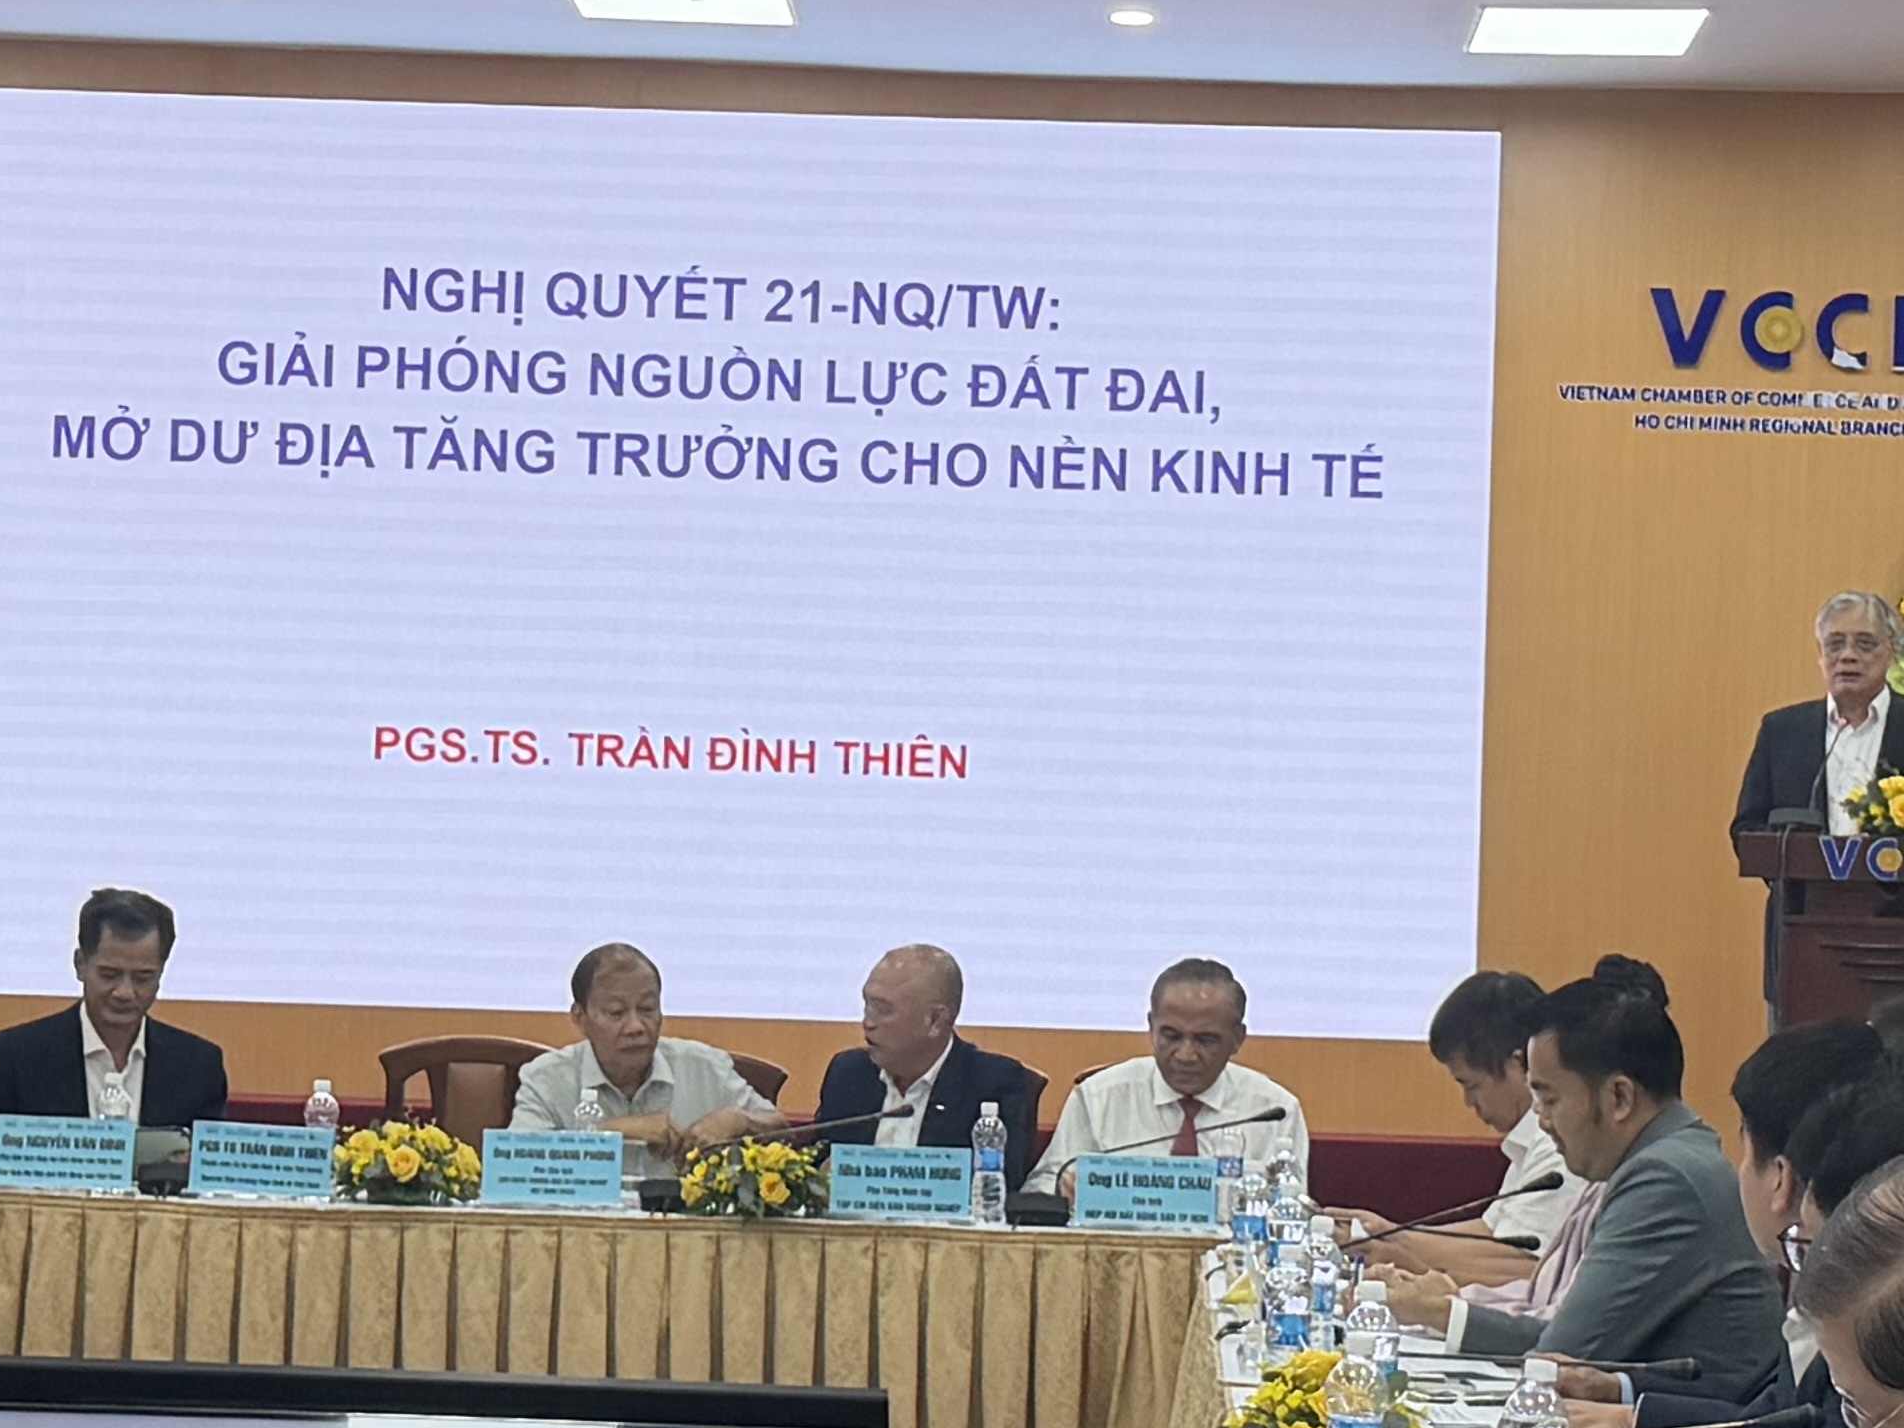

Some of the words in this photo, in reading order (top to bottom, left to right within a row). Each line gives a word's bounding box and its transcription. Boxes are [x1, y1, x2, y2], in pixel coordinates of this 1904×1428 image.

[383, 267, 525, 325] NGHỊ
[546, 265, 746, 320] QUYẾT
[765, 278, 1060, 330] 21-NQ/TW:
[217, 332, 334, 387] GIẢI
[357, 335, 567, 396] PHÓNG
[590, 346, 802, 401] NGUỒN
[826, 359, 948, 416] LỰC
[967, 355, 1089, 410] ĐẤT
[1105, 369, 1222, 423] ĐAI,
[1559, 383, 1636, 401] VIETNAM
[1640, 387, 1726, 405] CHAMBER
[1731, 389, 1753, 405] OF
[53, 405, 151, 460] MỞ
[170, 419, 259, 464] DƯ
[276, 422, 375, 478] ĐỊA
[394, 418, 556, 474] TĂNG
[577, 425, 838, 483] TRƯỞNG
[860, 439, 988, 487] CHO
[1009, 435, 1128, 491] NỀN
[1151, 449, 1290, 496] KINH
[1312, 443, 1383, 499] TẾ
[1635, 413, 1660, 430] HO
[1664, 415, 1694, 431] CHI
[1698, 416, 1745, 433] MINH
[1749, 417, 1836, 435] REGIONAL
[373, 726, 550, 766] PGS.TS.
[568, 725, 691, 771] TRẦN
[706, 727, 816, 774] ĐÌNH
[834, 734, 968, 779] THIÊN
